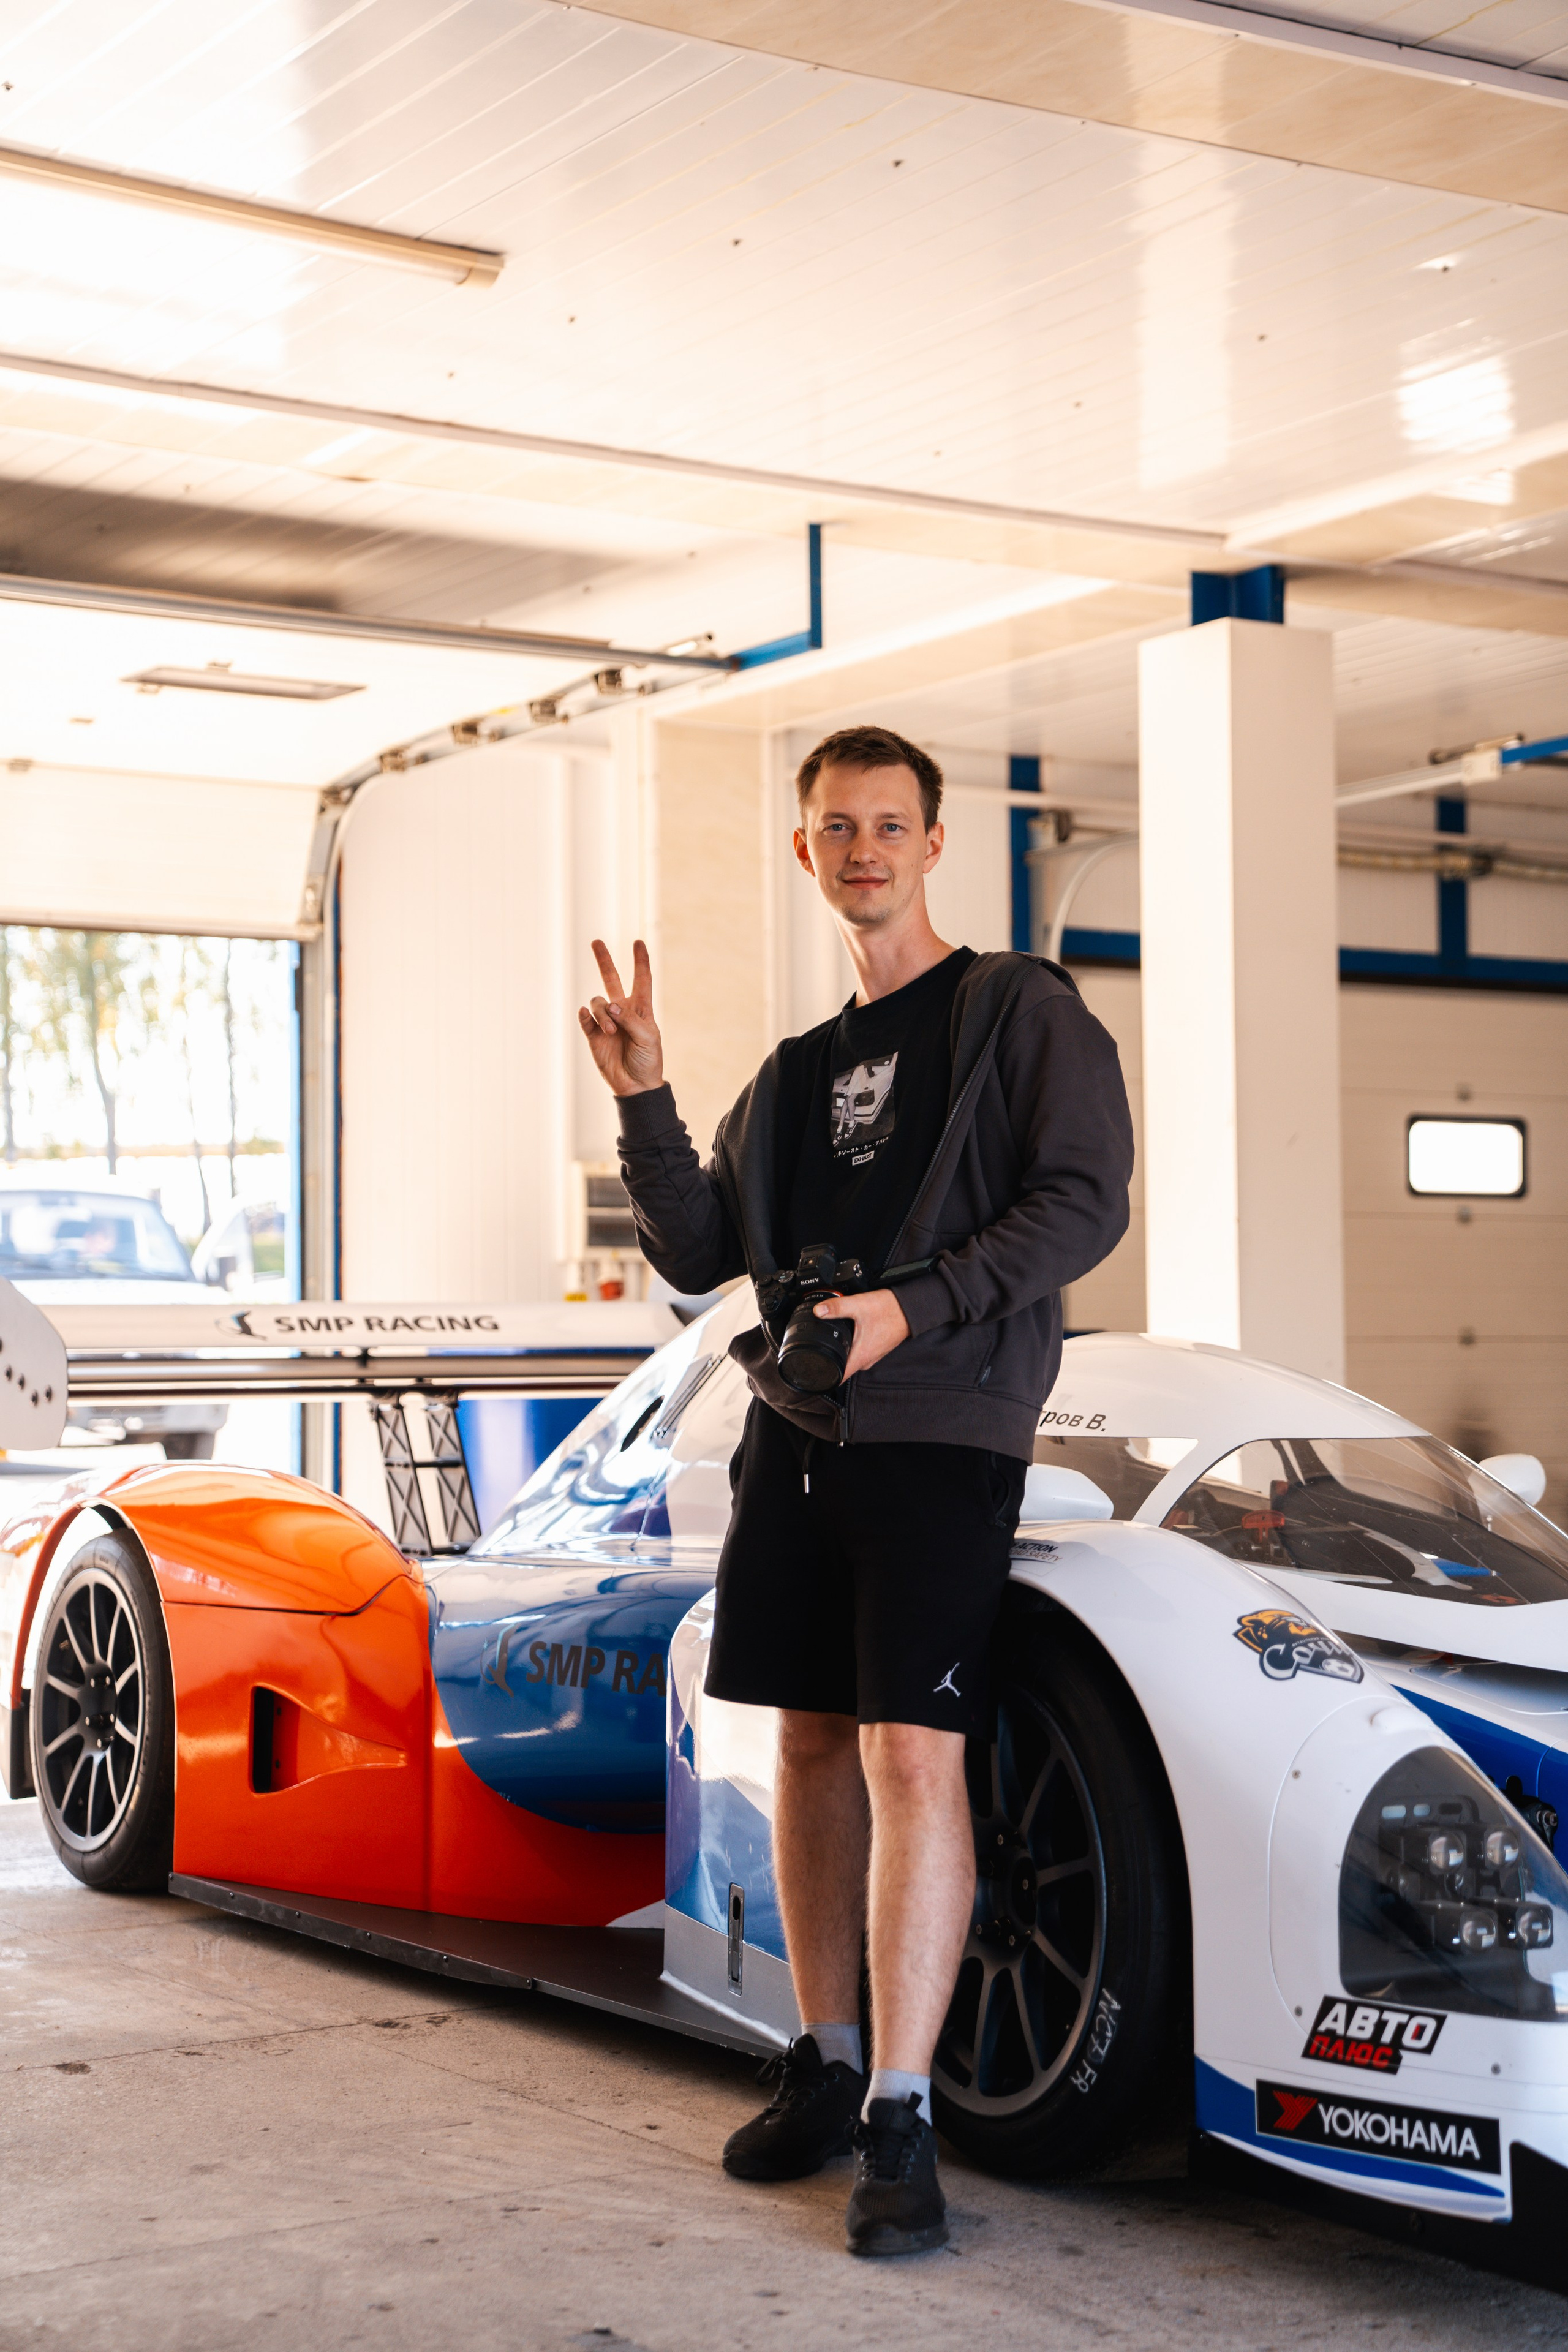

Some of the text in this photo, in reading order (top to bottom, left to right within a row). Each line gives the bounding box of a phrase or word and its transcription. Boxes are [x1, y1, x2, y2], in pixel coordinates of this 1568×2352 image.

[274, 1315, 500, 1332] SMP RACING
[1014, 1543, 1058, 1553] ACTION
[1026, 1550, 1063, 1562] SAFETY
[526, 1641, 666, 1697] SMP RA
[1317, 2002, 1438, 2049] АВТО
[1309, 2035, 1393, 2069] ПЛЮС
[1070, 2059, 1098, 2093] FR
[1317, 2103, 1481, 2160] YOKOHAMA
